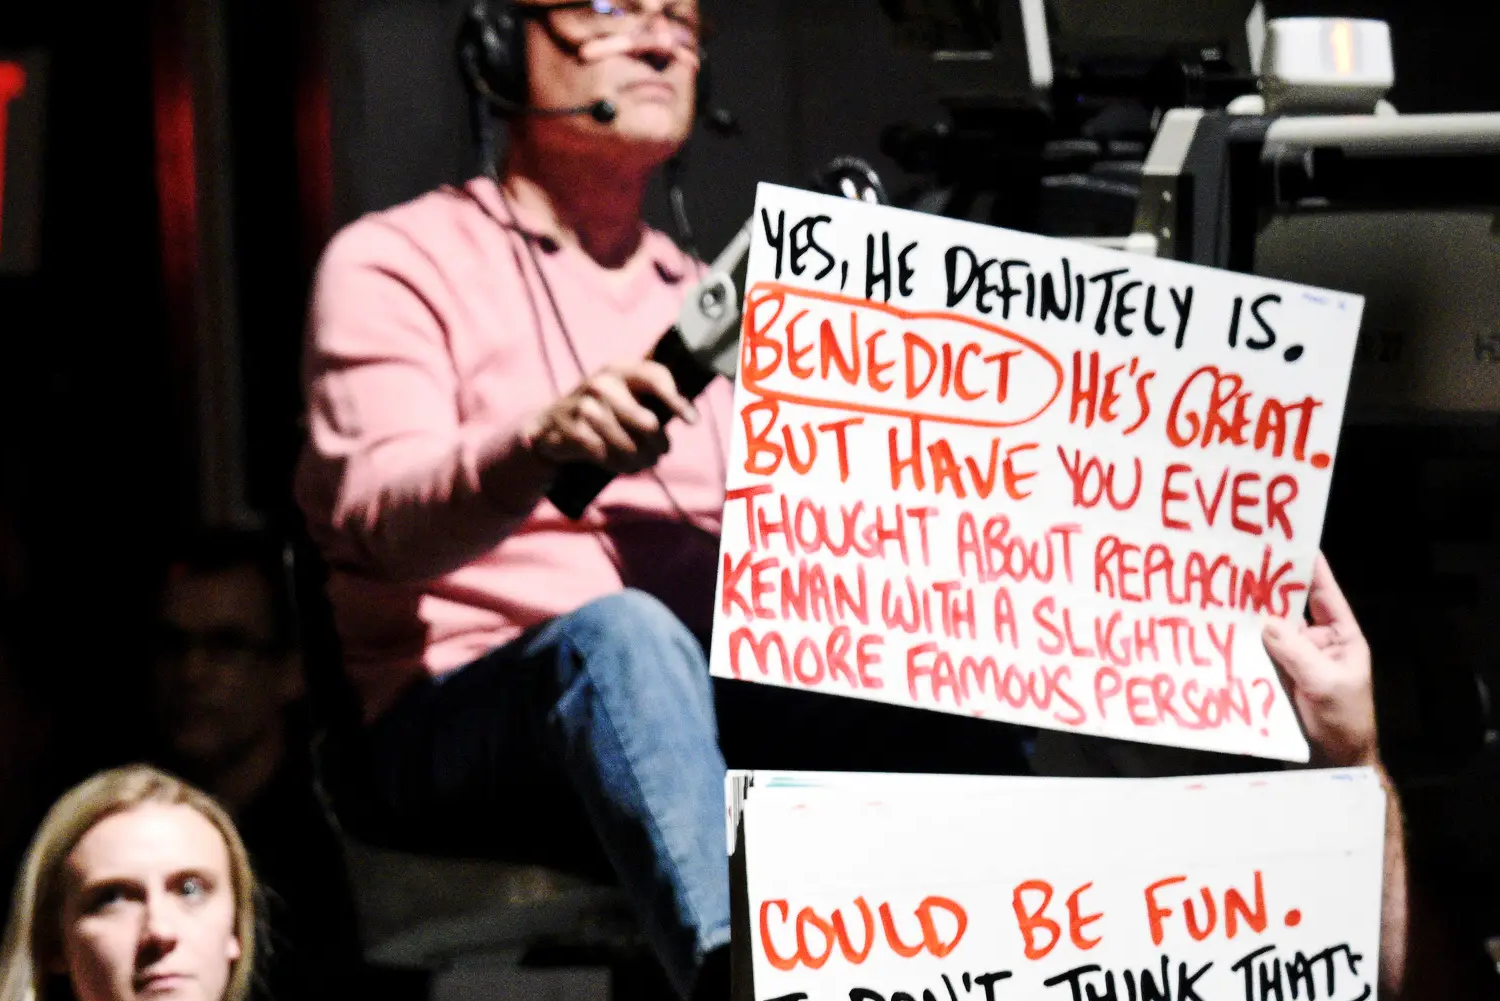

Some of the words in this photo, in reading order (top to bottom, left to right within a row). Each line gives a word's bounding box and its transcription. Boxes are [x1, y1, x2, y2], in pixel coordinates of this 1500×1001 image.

[761, 208, 848, 291] YES,
[865, 231, 918, 299] HE
[945, 244, 1193, 348] DEFINITELY
[1228, 294, 1306, 361] IS.
[745, 290, 1023, 404] BENEDICT
[1068, 350, 1157, 436] HE'S
[1166, 365, 1331, 468] GREAT.
[740, 402, 865, 484] BUT
[888, 412, 1040, 500] HAVE
[1056, 444, 1143, 512] YOU
[1161, 462, 1300, 541] EVER
[722, 551, 869, 625] KENAN
[881, 578, 977, 641] WITH
[993, 588, 1020, 650] A
[1032, 596, 1237, 681] SLIGHTLY
[725, 484, 939, 566] THOUGHT
[958, 512, 1082, 584] ABOUT
[1094, 535, 1306, 620] REPLACING
[728, 626, 885, 690] MORE
[906, 642, 1088, 728] FAMOUS
[1094, 667, 1277, 737] PERSON?
[758, 894, 968, 972] COULD
[1012, 878, 1106, 961] BE
[1143, 870, 1303, 947] FUN.
